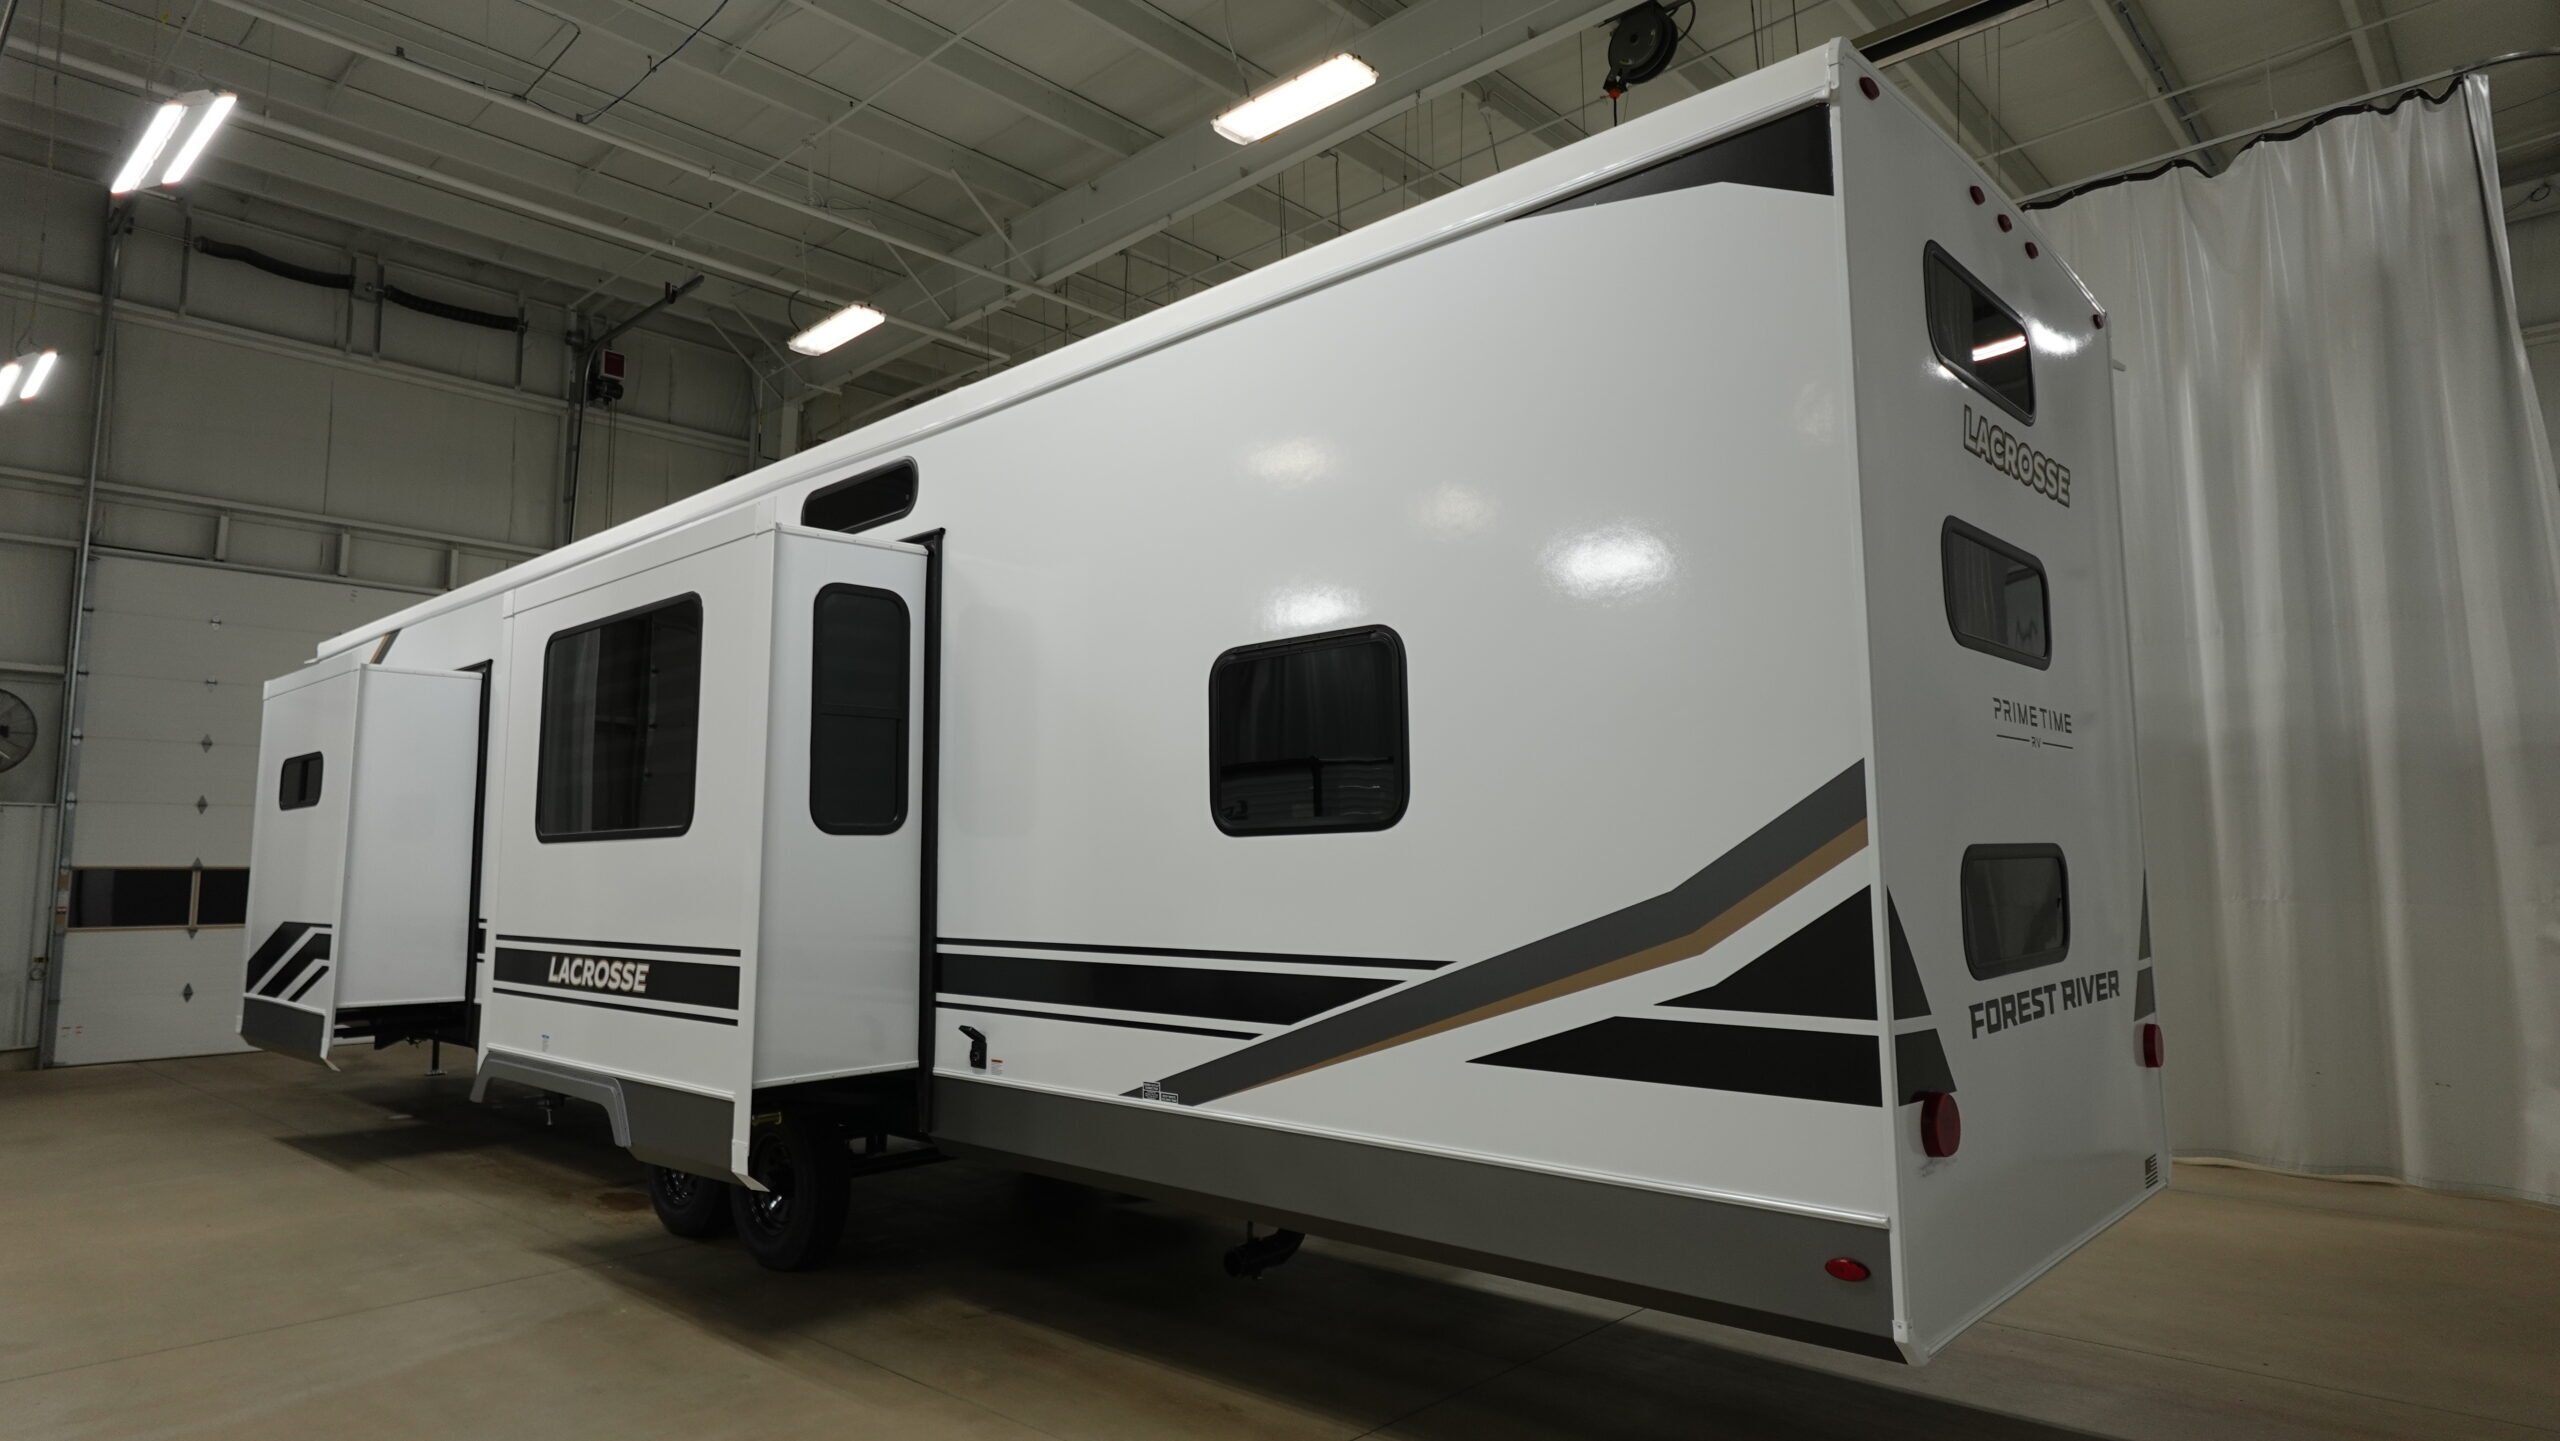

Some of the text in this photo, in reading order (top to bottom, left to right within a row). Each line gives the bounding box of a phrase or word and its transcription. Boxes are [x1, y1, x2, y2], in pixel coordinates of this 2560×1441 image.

[1963, 404, 2071, 508] LACROSSE
[548, 956, 650, 993] LACROSSE
[1968, 970, 2120, 1040] FOREST RIVER
